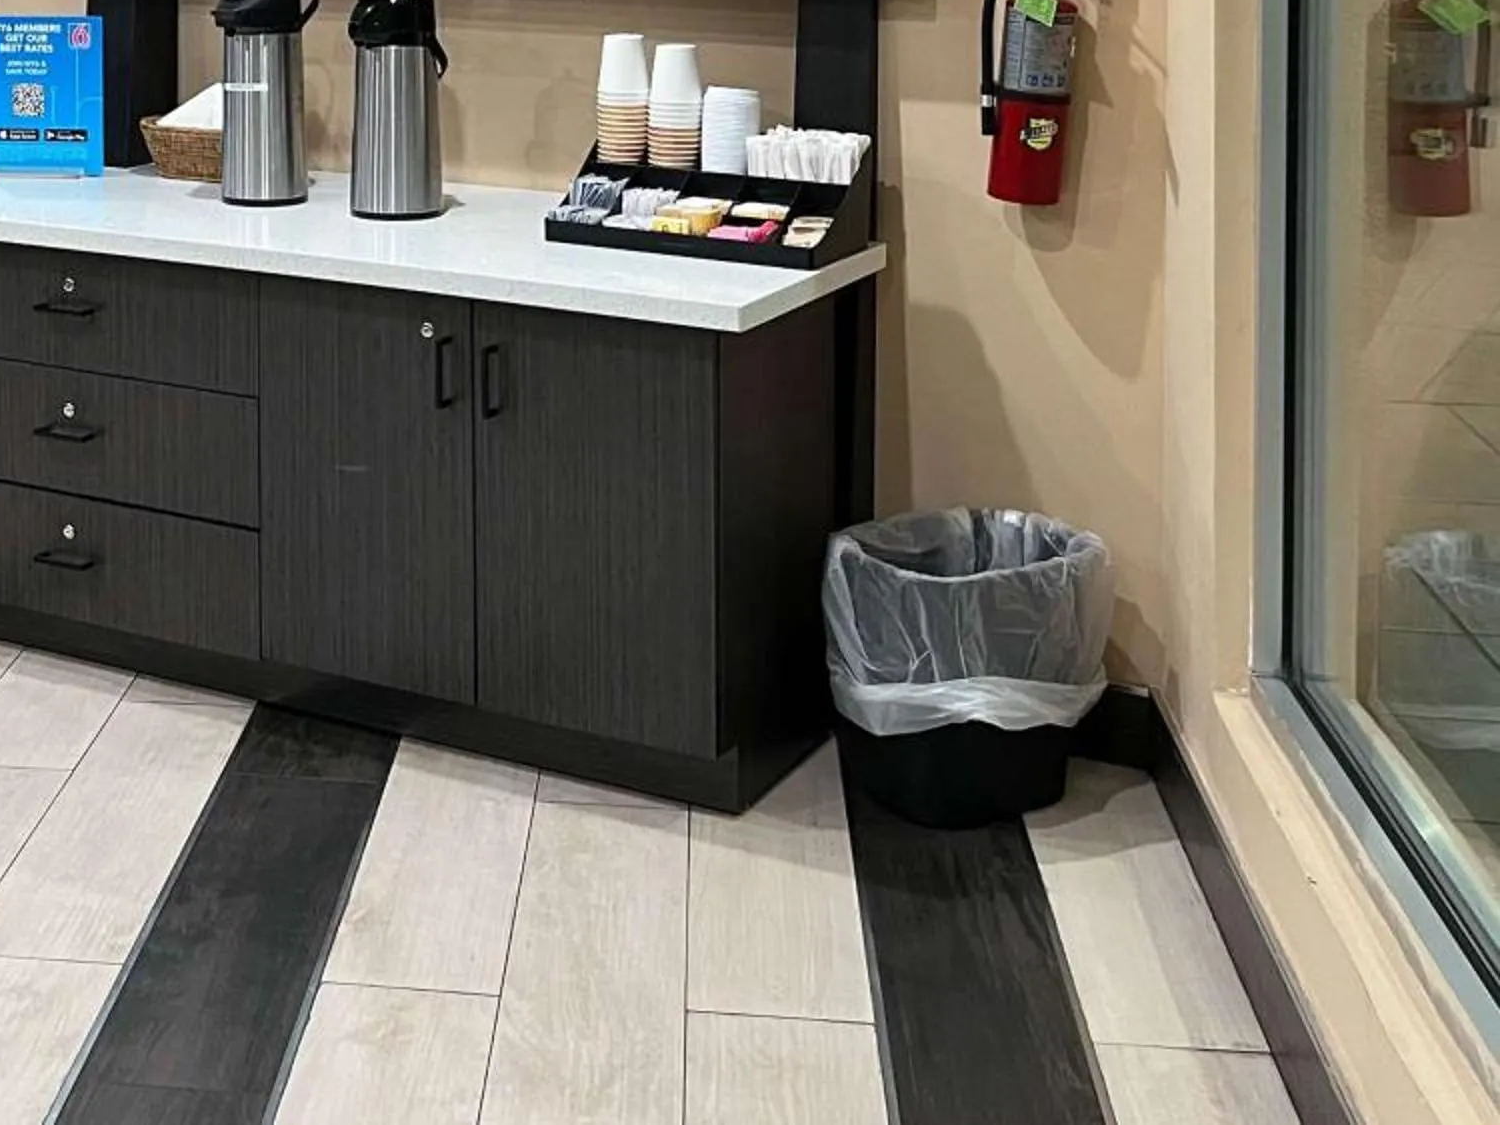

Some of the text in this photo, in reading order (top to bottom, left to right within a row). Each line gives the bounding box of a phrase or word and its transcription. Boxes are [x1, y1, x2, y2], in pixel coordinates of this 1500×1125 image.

[14, 23, 61, 34] MEMBERS
[4, 33, 48, 43] GET OUR
[0, 43, 54, 54] BEST RATES
